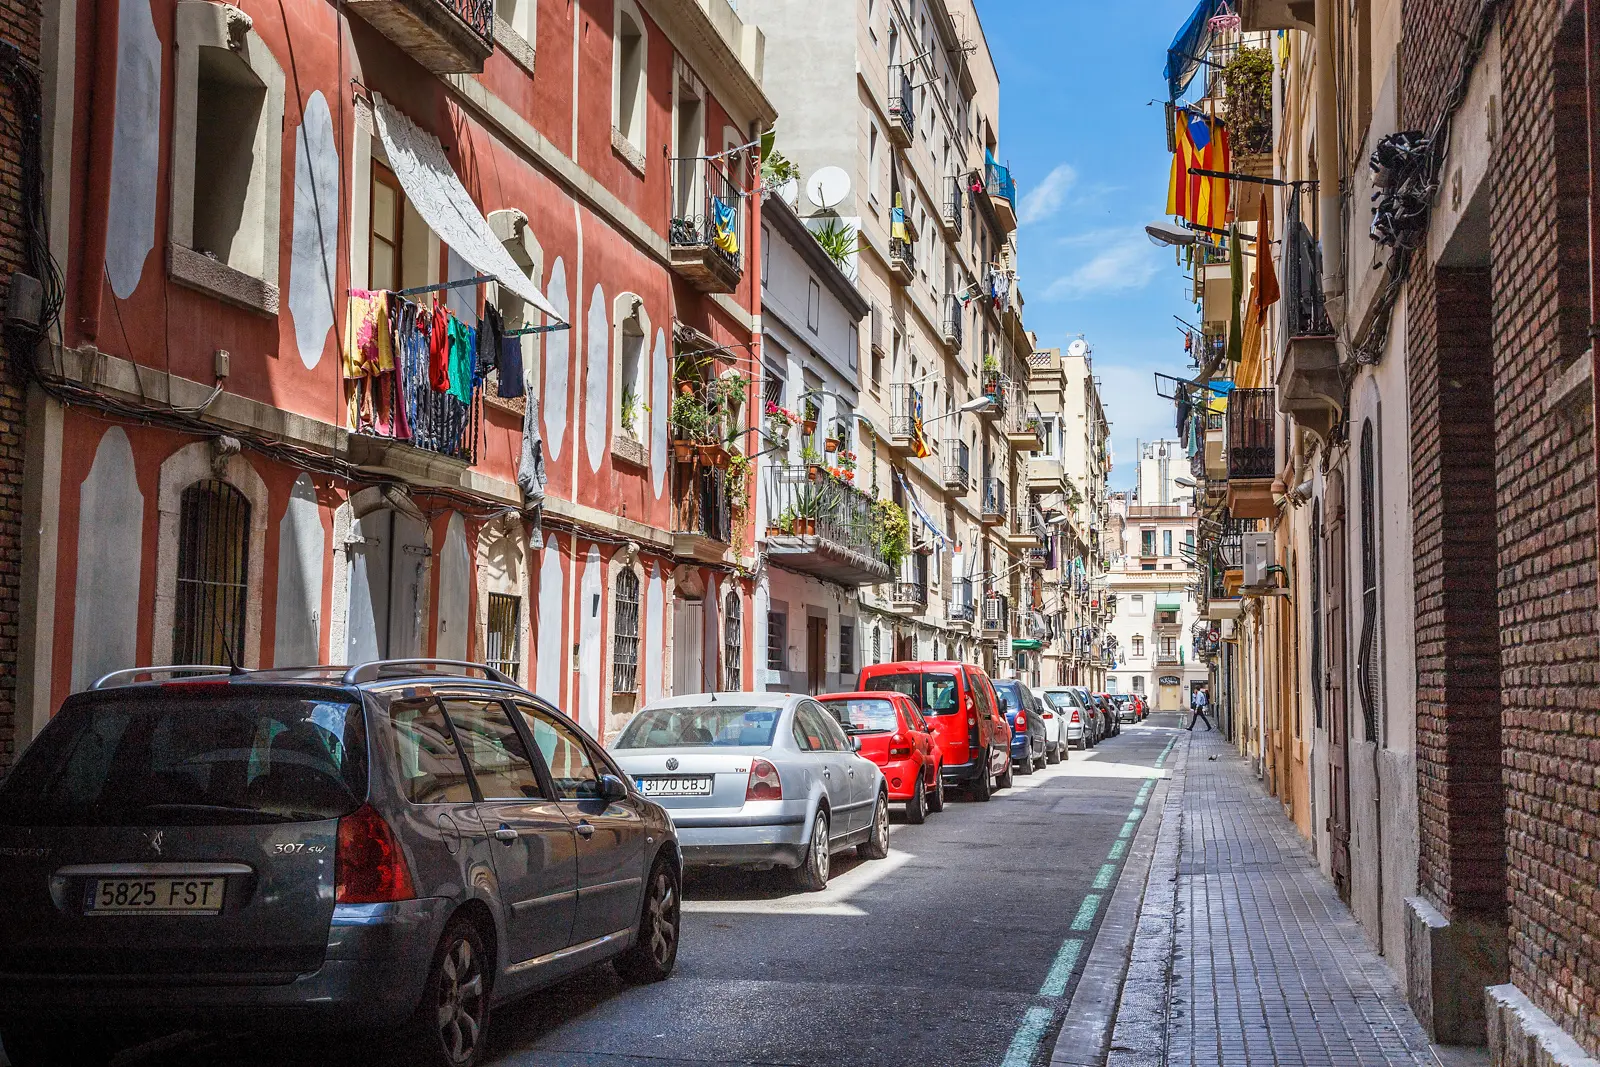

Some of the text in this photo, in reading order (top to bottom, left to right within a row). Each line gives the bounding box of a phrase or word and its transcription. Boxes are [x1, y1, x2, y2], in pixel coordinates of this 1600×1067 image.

[645, 779, 707, 791] 3170 CBJ
[273, 843, 304, 854] 307
[102, 881, 214, 905] 5825 FST
